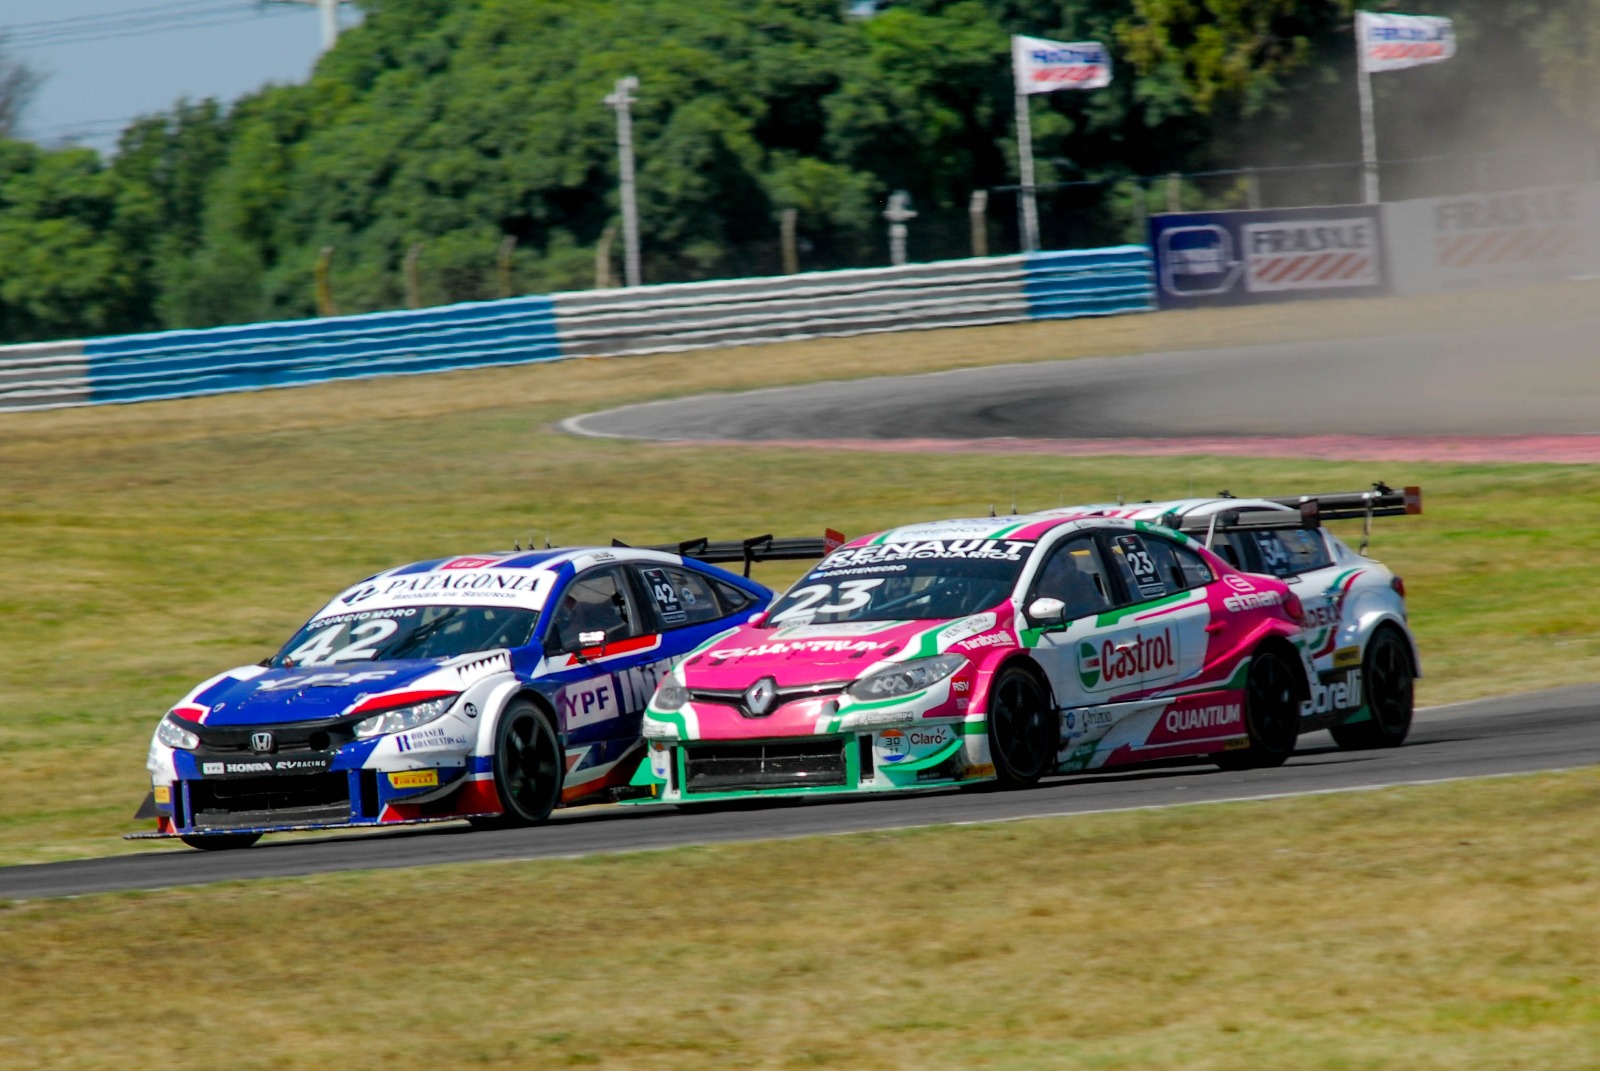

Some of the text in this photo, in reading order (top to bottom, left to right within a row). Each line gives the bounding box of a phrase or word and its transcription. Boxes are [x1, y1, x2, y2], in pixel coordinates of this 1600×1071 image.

[817, 551, 1021, 571] CONCESIONARIOS
[822, 539, 1035, 565] RENAULT
[823, 565, 907, 578] MONTENEGRO
[1127, 551, 1155, 576] 23
[382, 574, 540, 594] PATAGONIA
[654, 583, 678, 603] 42
[772, 579, 885, 625] 23
[1223, 590, 1282, 613] etman
[306, 612, 370, 631] SCUNCIO
[944, 616, 988, 638] VENTURINO
[287, 619, 398, 666] 42
[1102, 627, 1174, 682] Castrol
[257, 670, 397, 691] YPF
[952, 681, 969, 691] RSV
[465, 704, 477, 716] 42
[564, 686, 610, 717] YPF
[1166, 704, 1241, 733] QUANTIUM
[886, 737, 900, 746] 30
[910, 732, 943, 745] Claro
[227, 762, 273, 773] HONDA
